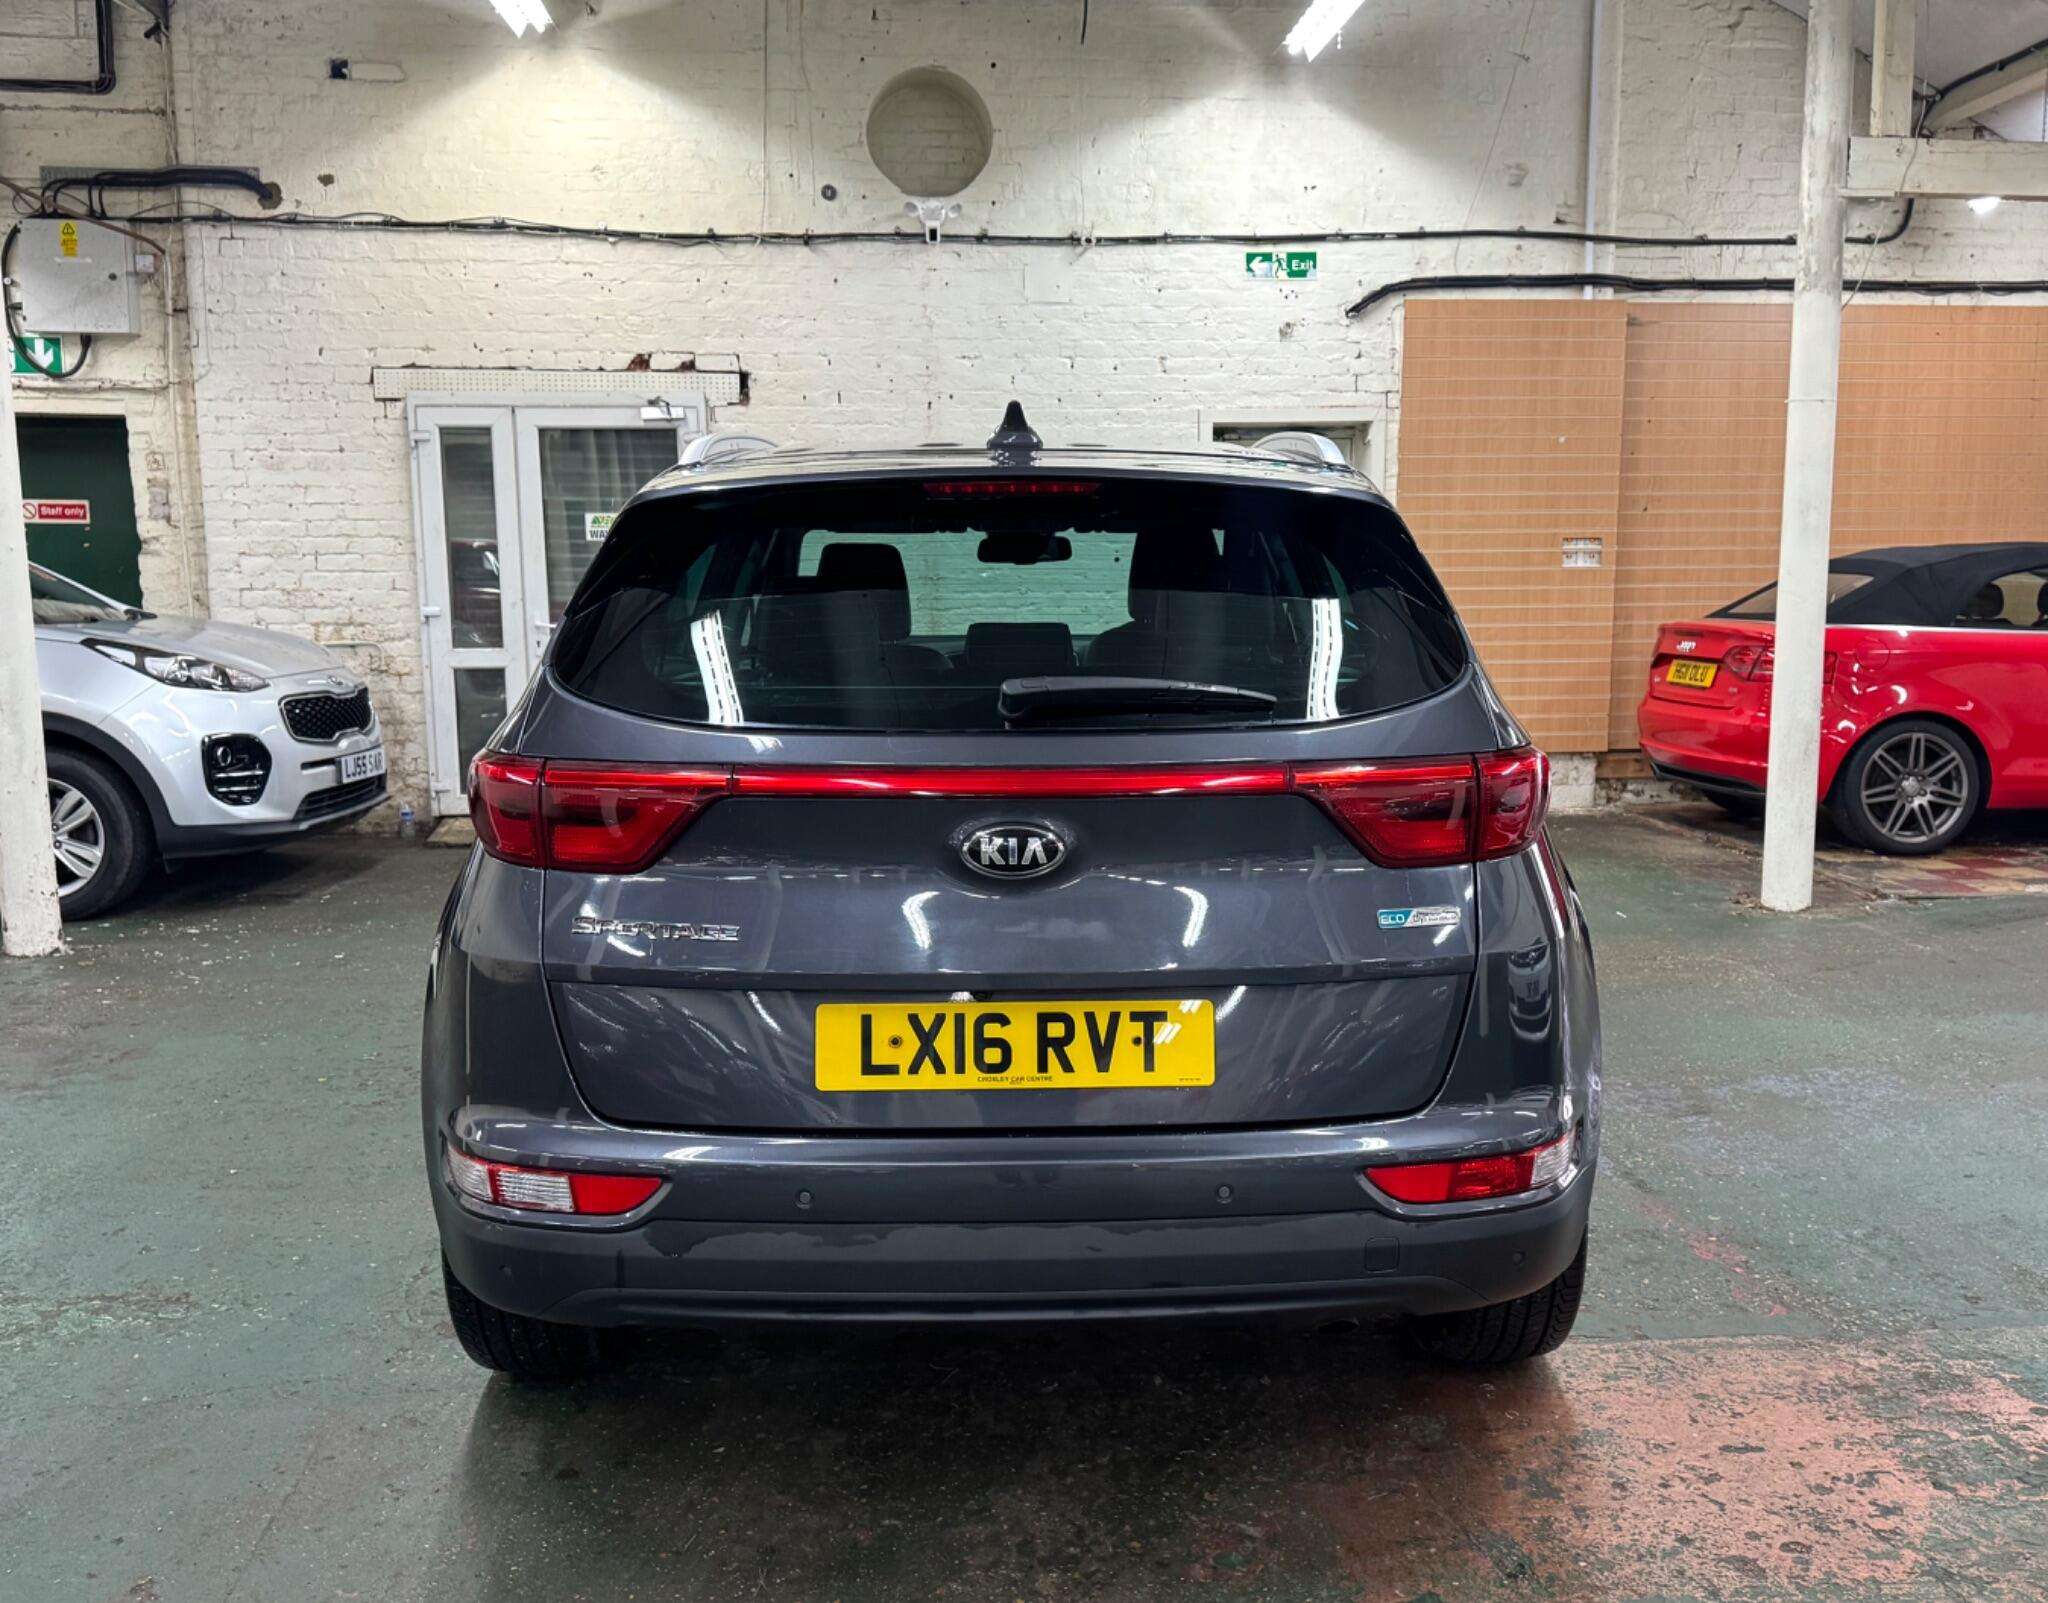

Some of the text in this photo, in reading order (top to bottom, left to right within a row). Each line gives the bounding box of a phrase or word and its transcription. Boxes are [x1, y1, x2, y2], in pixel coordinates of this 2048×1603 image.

[1291, 259, 1314, 271] Exit
[40, 505, 85, 519] Staff only
[344, 754, 367, 778] LJ55
[980, 836, 1048, 865] KIA
[572, 916, 740, 941] SPORTAGE
[1380, 914, 1405, 925] ECO
[860, 1011, 1169, 1076] LX16 RVT
